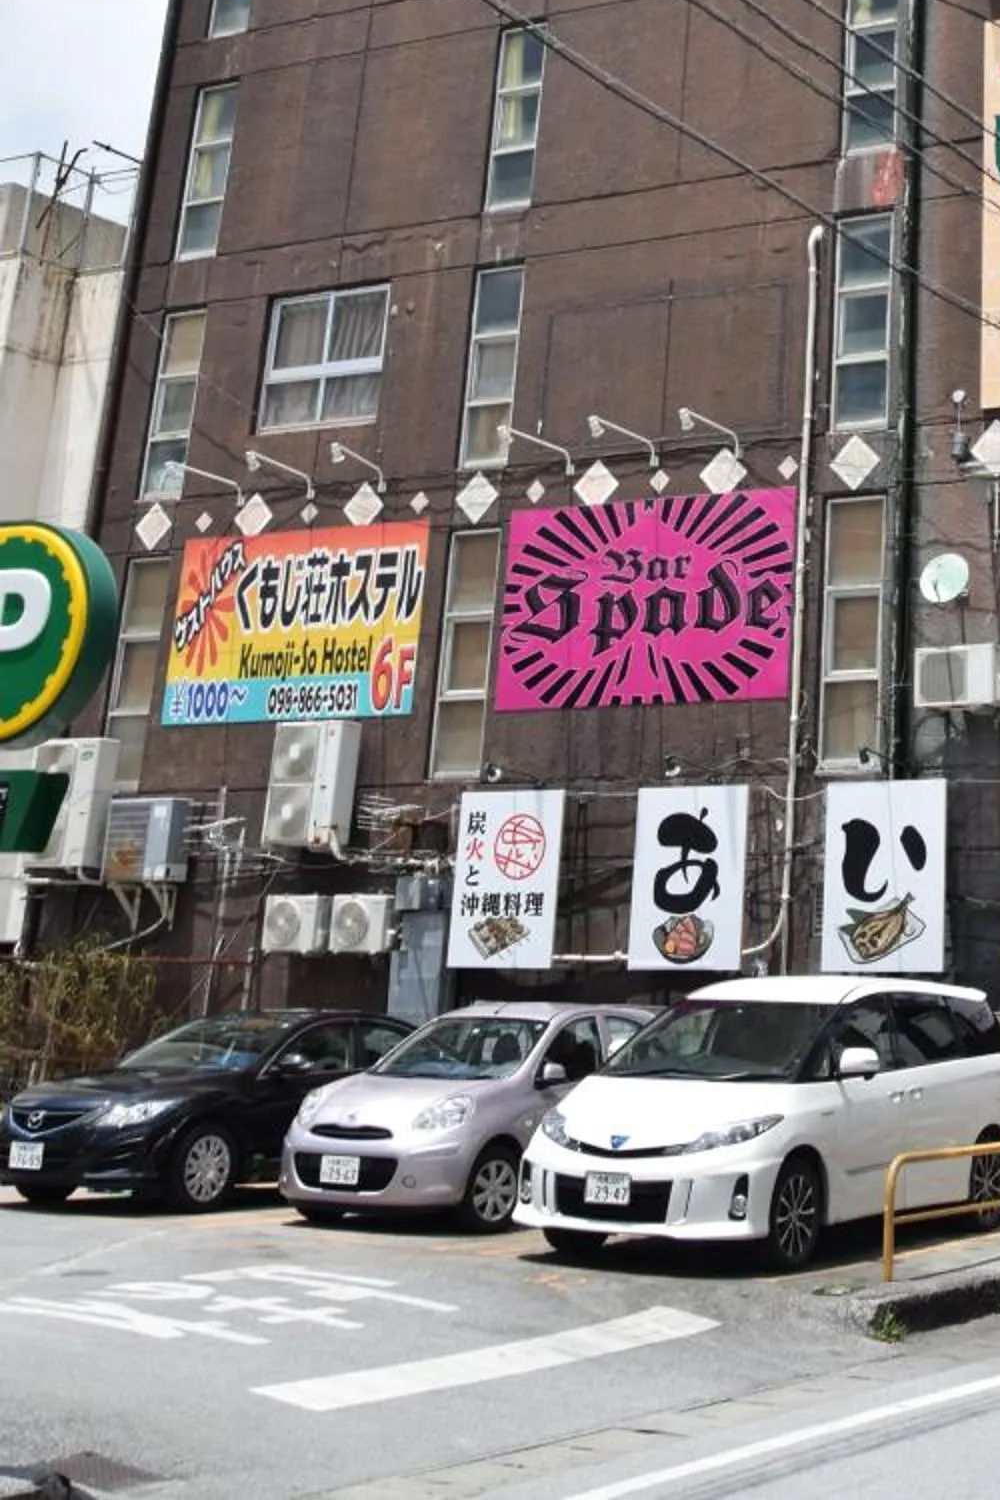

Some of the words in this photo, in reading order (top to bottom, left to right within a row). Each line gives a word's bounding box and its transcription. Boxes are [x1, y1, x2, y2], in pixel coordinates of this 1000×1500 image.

[236, 547, 423, 632] くもじ荘ホステル
[601, 549, 692, 584] Bar
[508, 560, 786, 657] Spade
[239, 647, 318, 681] Kumoji-So
[321, 636, 371, 673] Hostel
[371, 638, 415, 713] 6F
[267, 682, 359, 715] 098-866-5031
[464, 810, 487, 887] 炭火と
[653, 807, 720, 914] あ
[841, 818, 927, 902] い
[460, 891, 545, 917] 沖縄料理
